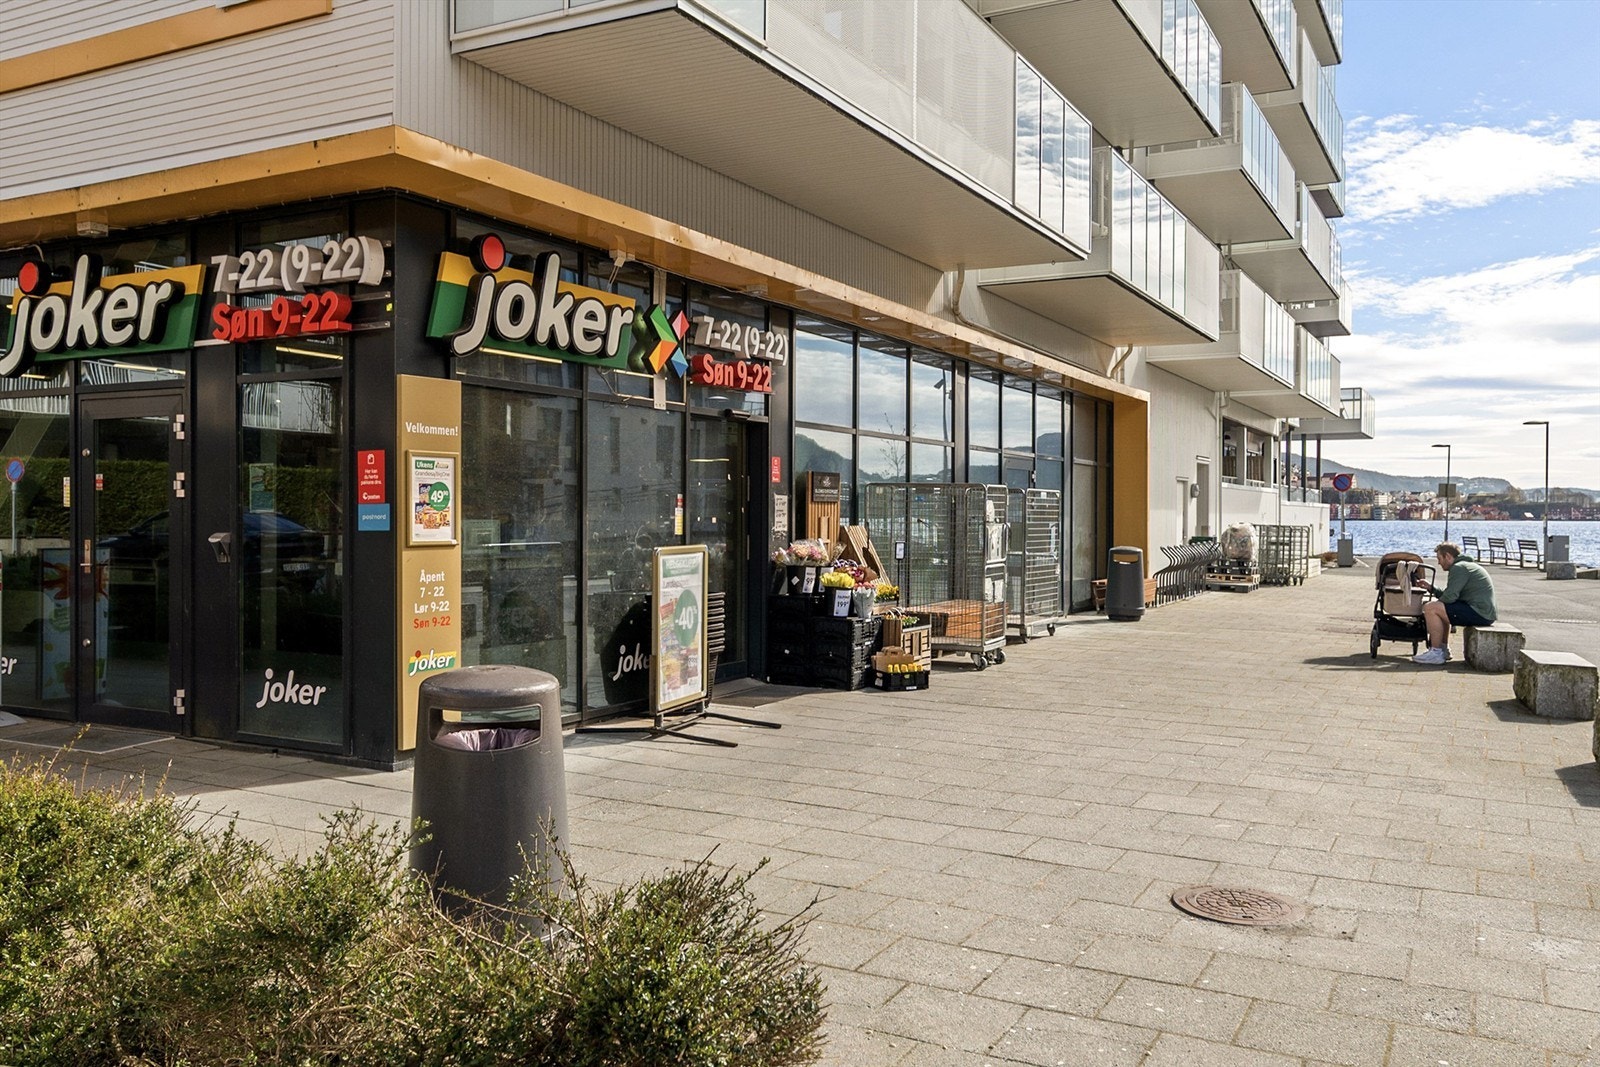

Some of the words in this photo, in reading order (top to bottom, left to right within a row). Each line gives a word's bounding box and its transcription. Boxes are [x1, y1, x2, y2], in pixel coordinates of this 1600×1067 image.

[211, 248, 275, 293] 7-22
[281, 236, 375, 292] (9-22)
[0, 253, 172, 376] joker
[453, 235, 634, 355] joker
[212, 304, 265, 342] Søn
[272, 290, 342, 336] 9-22
[703, 315, 742, 352] 7-22
[744, 324, 789, 366] (9-22)
[702, 352, 734, 389] Søn
[737, 357, 773, 392] 9-22
[405, 421, 459, 437] Velkommen!
[419, 569, 445, 584] Åpent
[420, 587, 426, 598] 7
[433, 586, 445, 597] 22
[413, 618, 430, 629] Søn
[432, 615, 451, 627] 9-22
[414, 602, 428, 614] Lør
[430, 600, 450, 612] 9-22
[408, 650, 453, 677] joker
[612, 642, 649, 682] jok
[256, 667, 326, 709] joker
